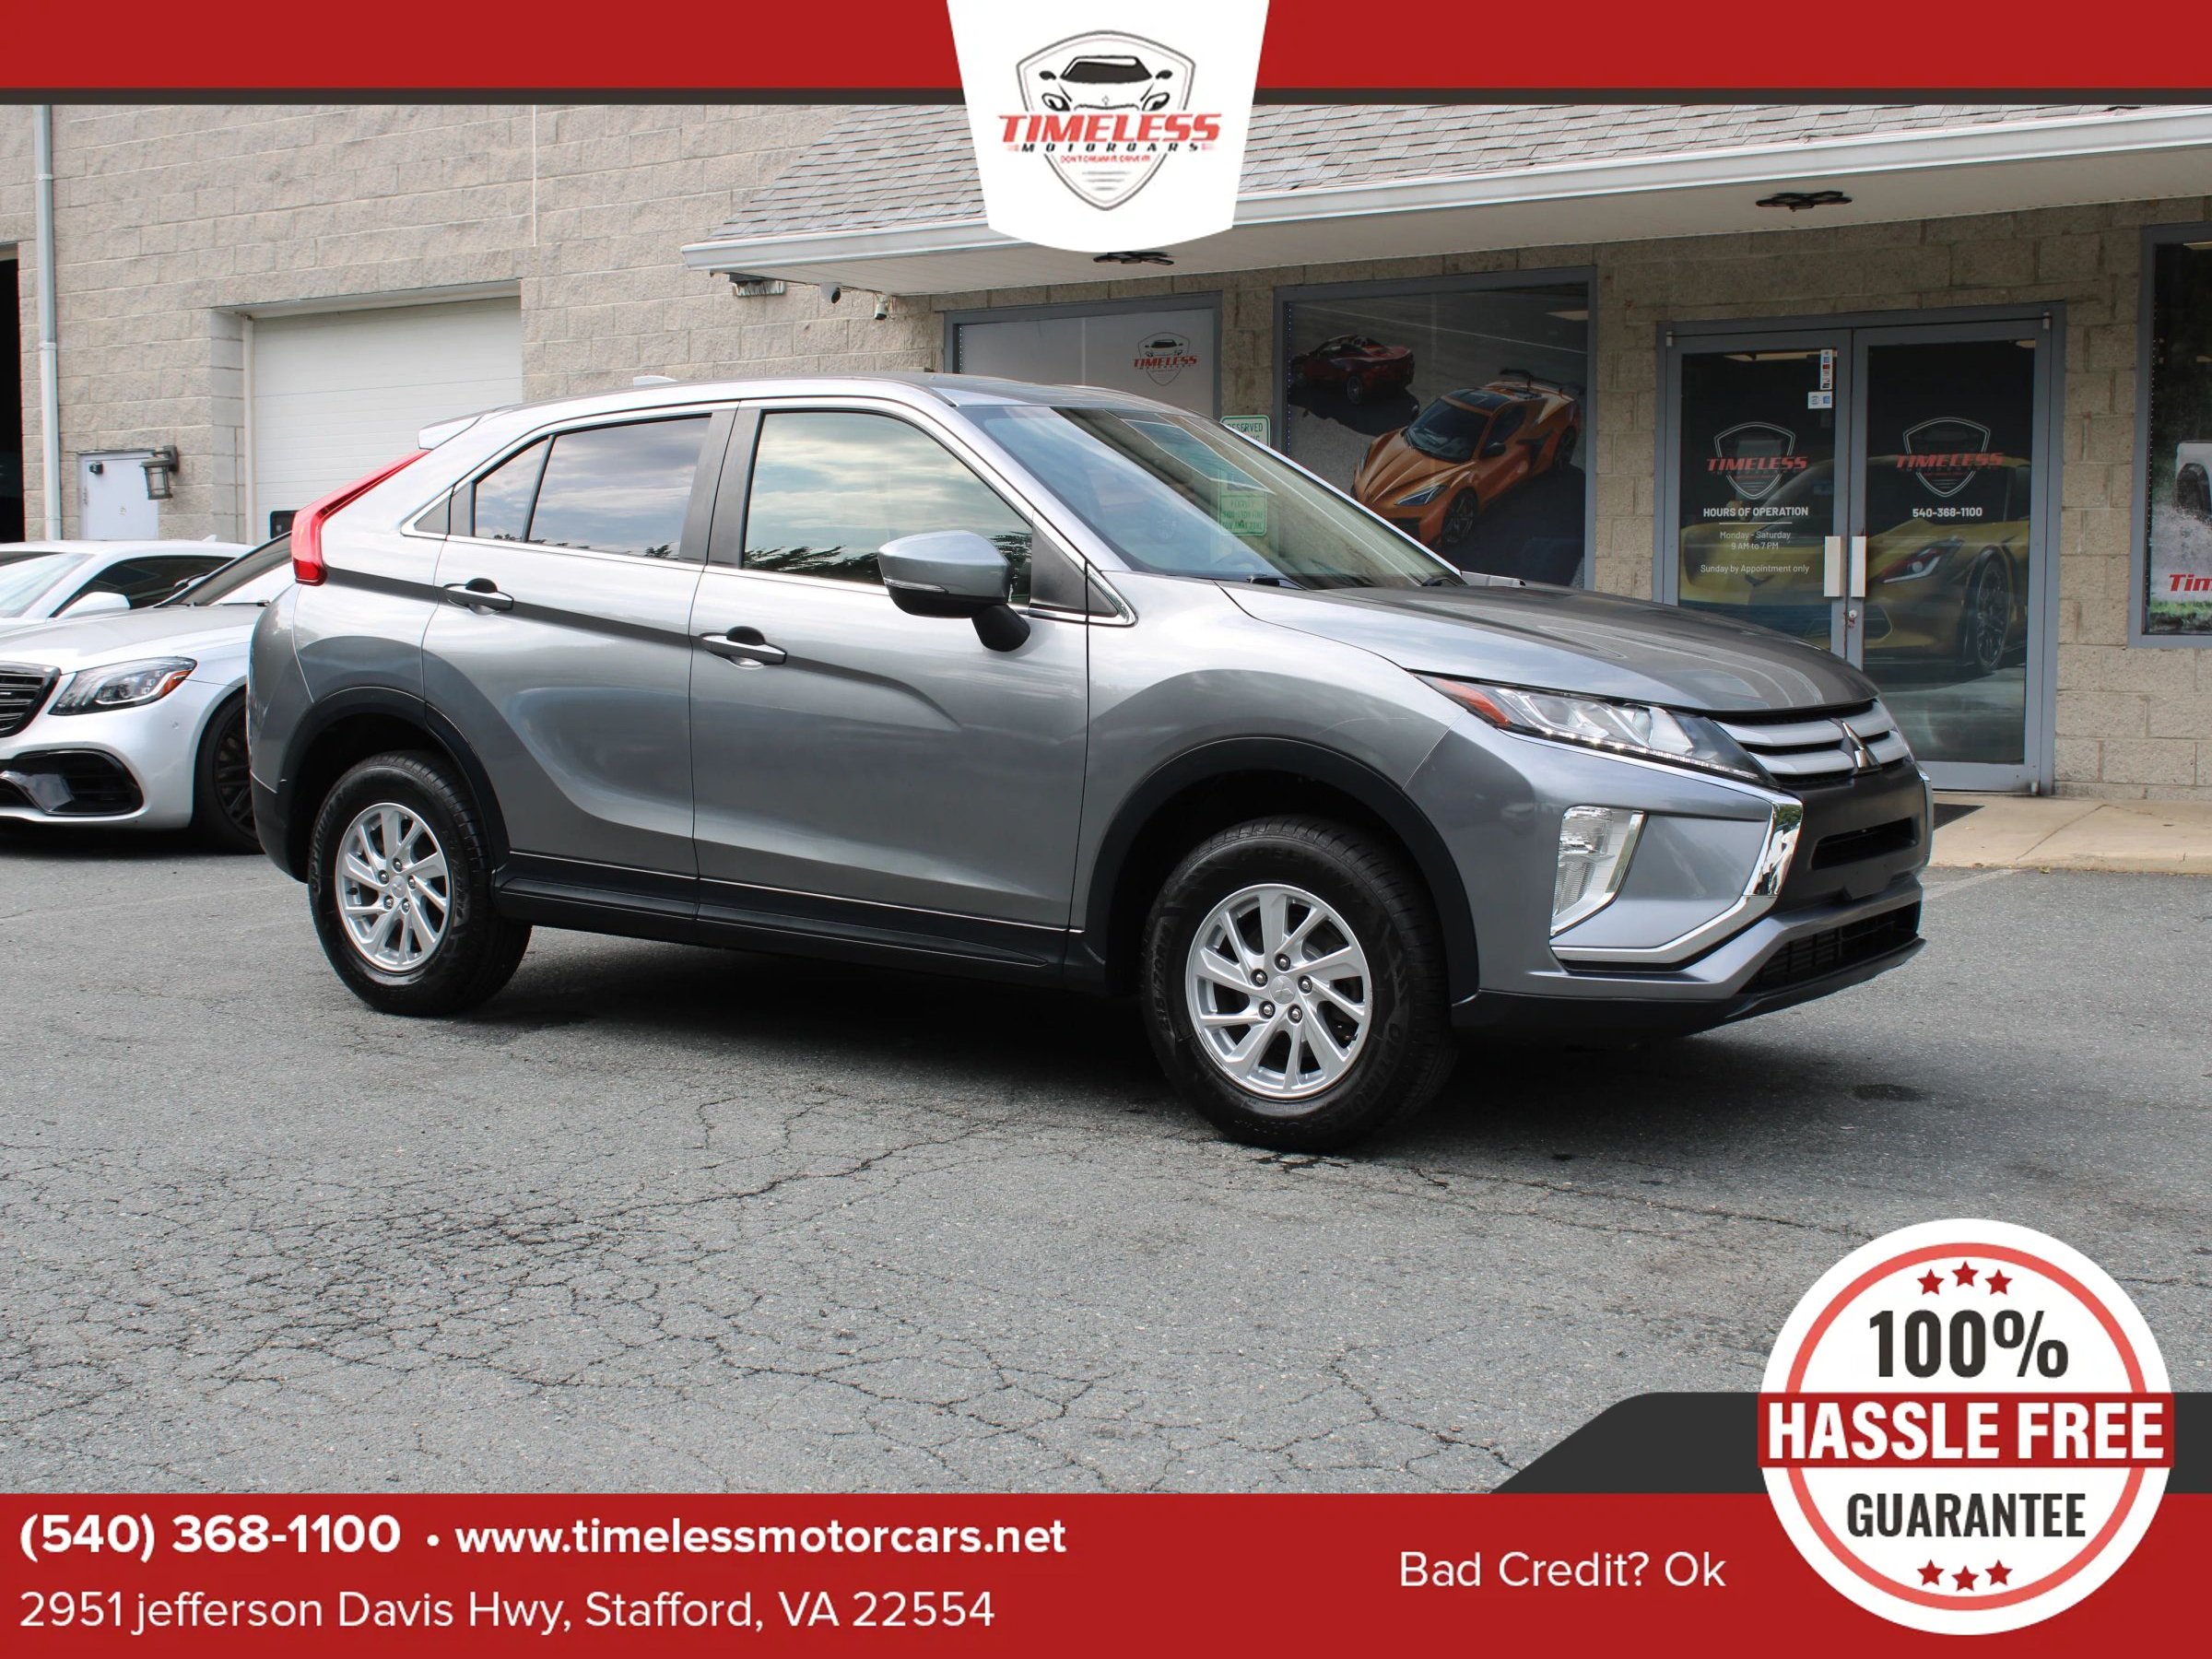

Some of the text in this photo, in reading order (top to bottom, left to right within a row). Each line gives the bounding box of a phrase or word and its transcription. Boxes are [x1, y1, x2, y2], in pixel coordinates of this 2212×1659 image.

[1135, 355, 1198, 367] TIMELESS
[1707, 456, 1808, 471] TIMELESS
[1897, 453, 2005, 468] TIMELESS
[1703, 507, 1808, 517] HOURS OF OPERATION
[1912, 507, 1983, 517] 540-368-1100
[1720, 531, 1748, 540] Monday
[1756, 531, 1791, 540] Saturday
[1737, 542, 1749, 550] AM
[1767, 541, 1779, 549] PM
[1700, 564, 1810, 574] Sunday by Appointment only
